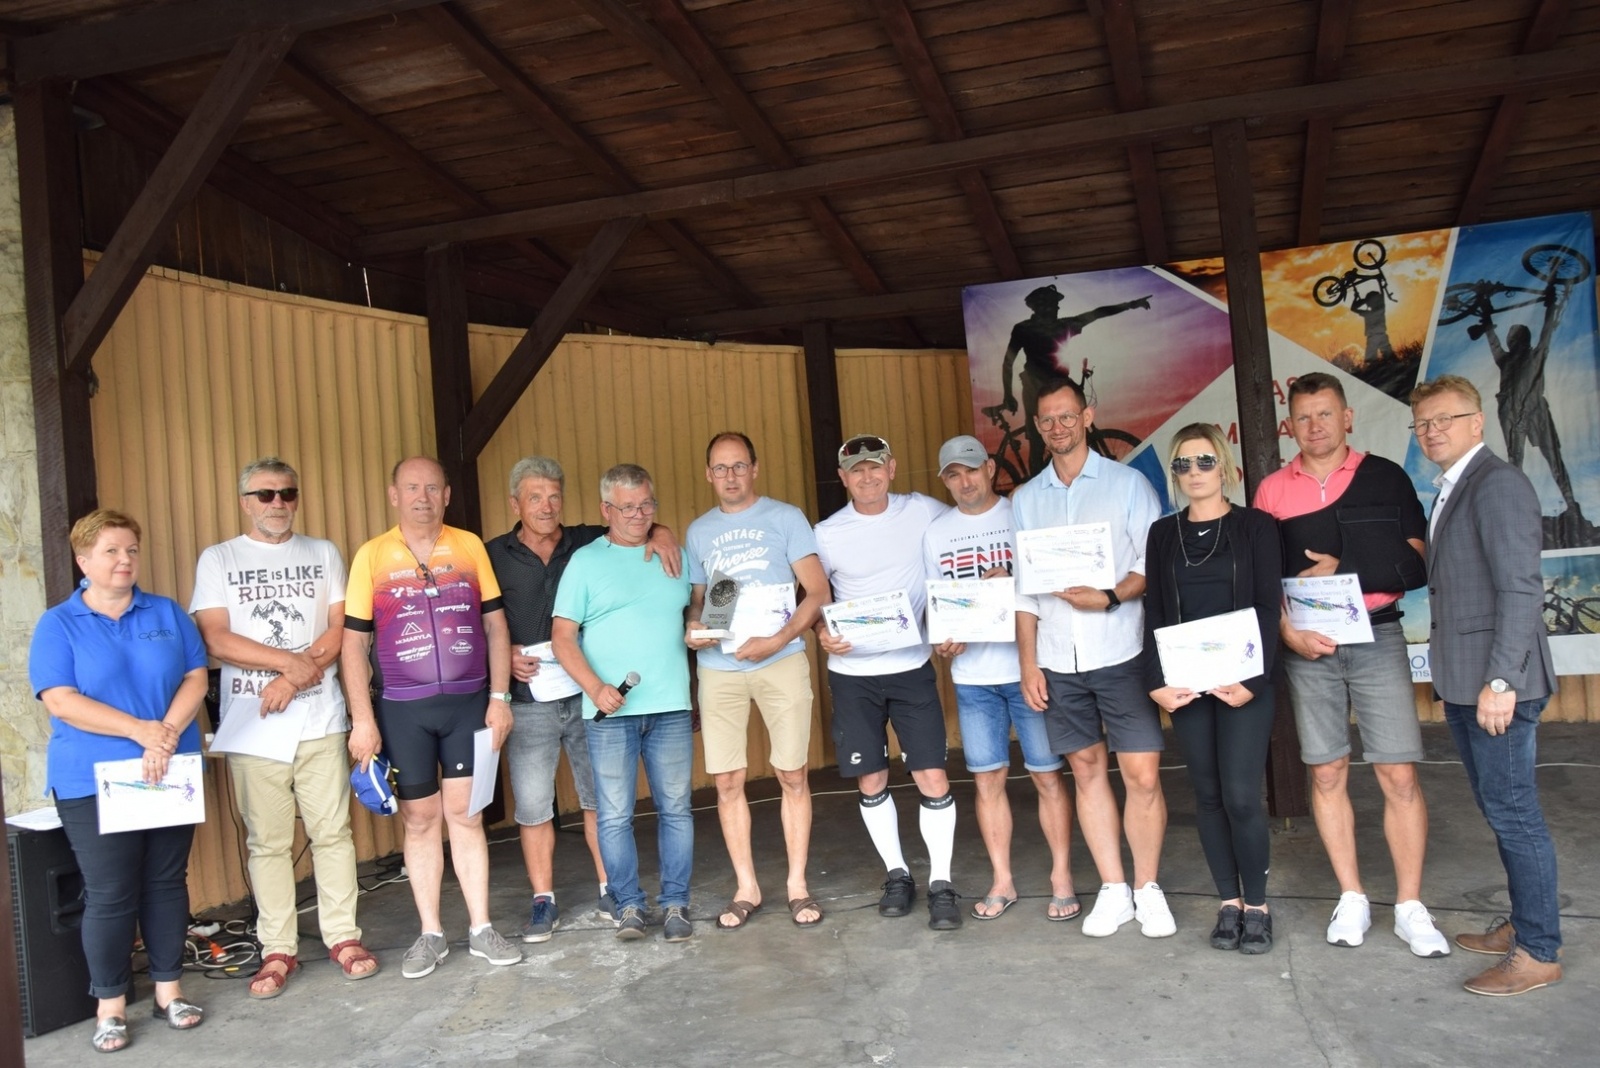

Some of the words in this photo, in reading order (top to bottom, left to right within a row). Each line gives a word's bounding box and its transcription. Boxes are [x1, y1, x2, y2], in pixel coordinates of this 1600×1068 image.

[712, 528, 765, 548] VINTAGE
[950, 534, 979, 543] ORIGINAL
[982, 528, 1010, 537] CONCEPT
[228, 569, 269, 586] LIFE
[285, 565, 324, 582] LIKE
[238, 581, 315, 605] RIDING
[294, 687, 323, 701] MOVING
